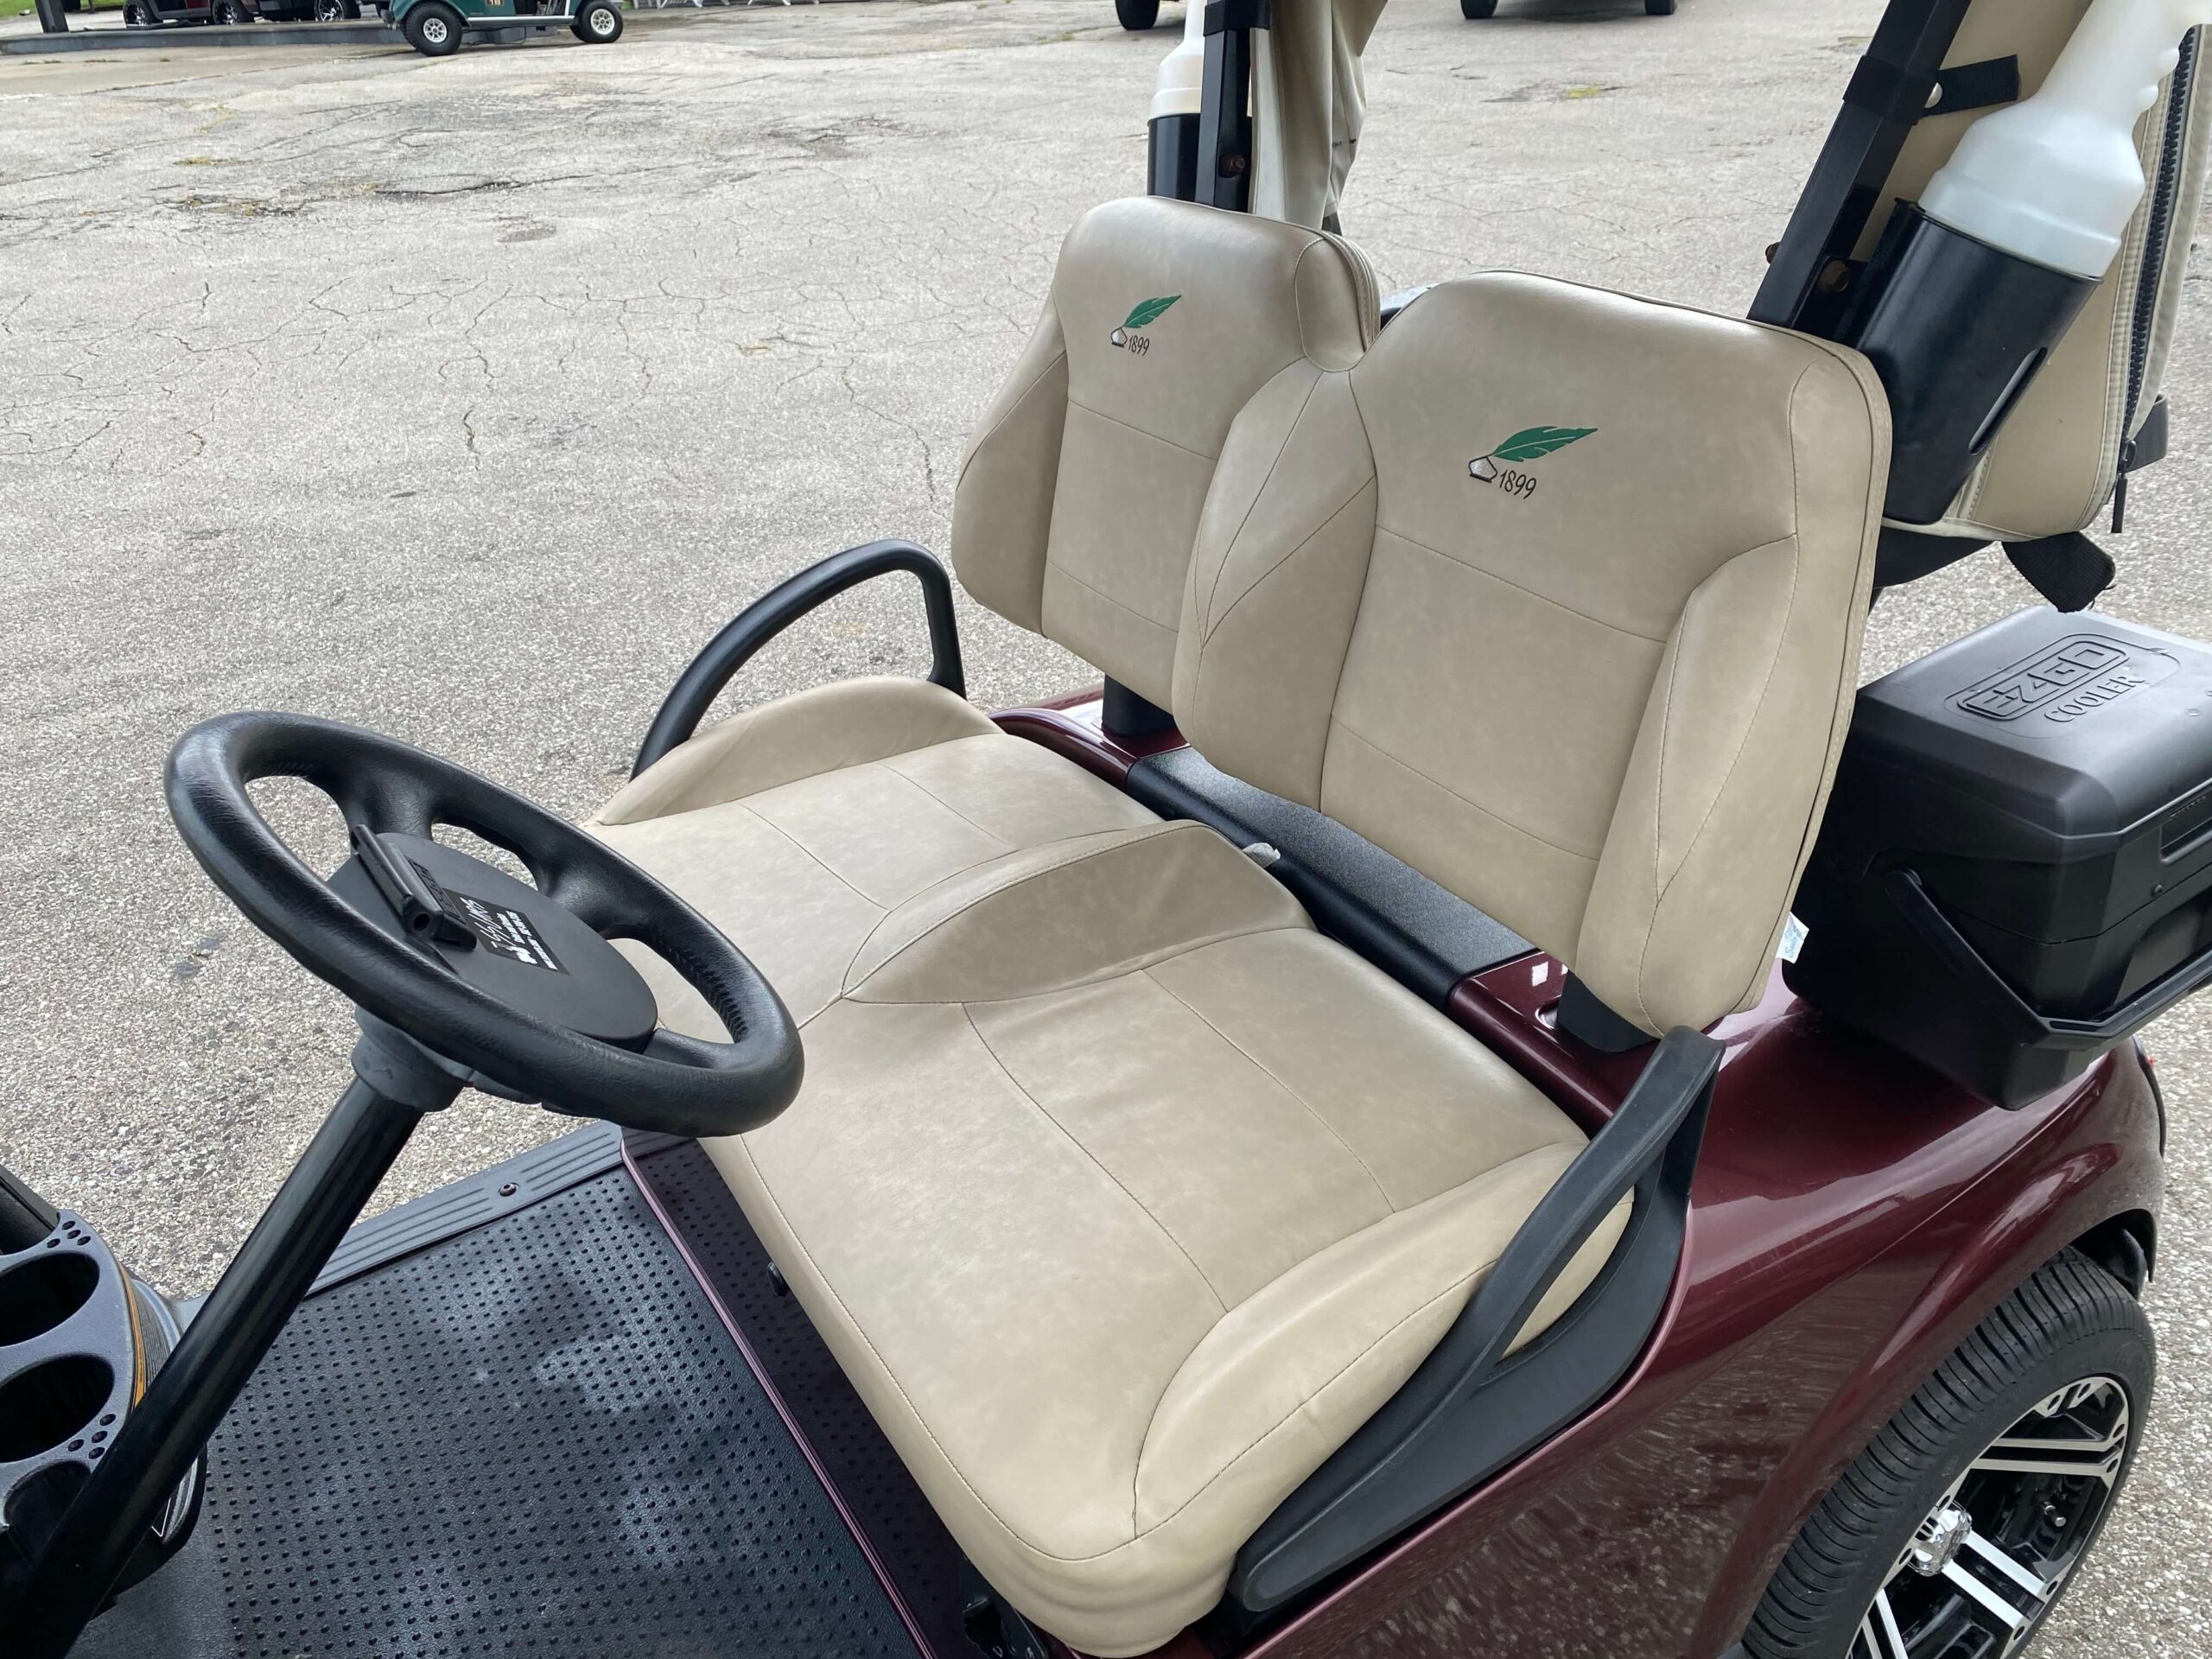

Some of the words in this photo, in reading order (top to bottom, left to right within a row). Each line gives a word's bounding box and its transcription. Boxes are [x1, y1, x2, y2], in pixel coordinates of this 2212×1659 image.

[1128, 334, 1150, 357] 1899
[1499, 469, 1537, 499] 1899
[2044, 675, 2146, 722] COOLER
